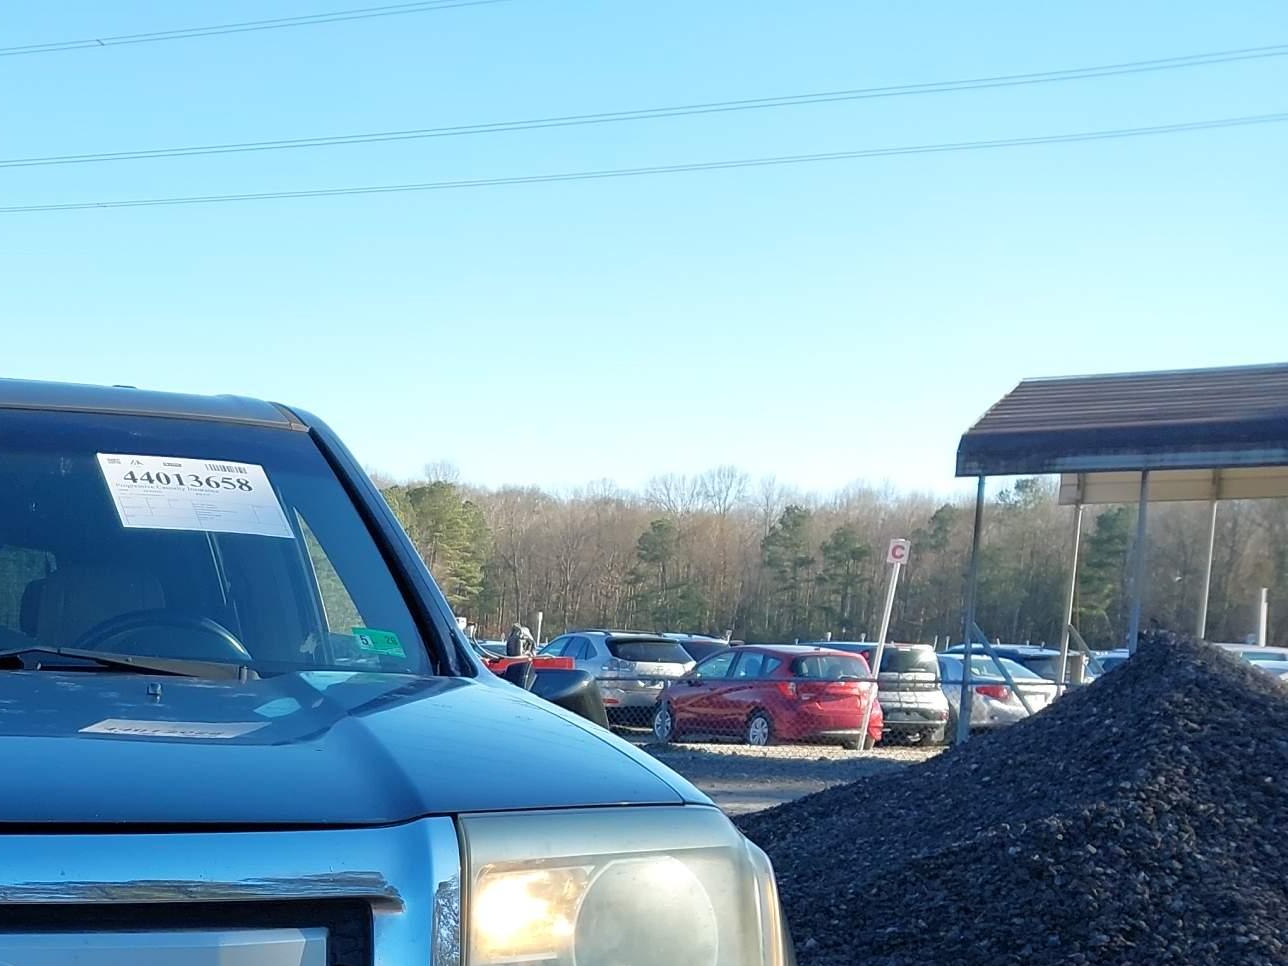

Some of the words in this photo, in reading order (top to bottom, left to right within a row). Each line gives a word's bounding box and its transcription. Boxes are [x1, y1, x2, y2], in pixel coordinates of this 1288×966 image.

[123, 470, 253, 492] 44013658
[891, 544, 905, 559] C
[359, 634, 369, 645] 5
